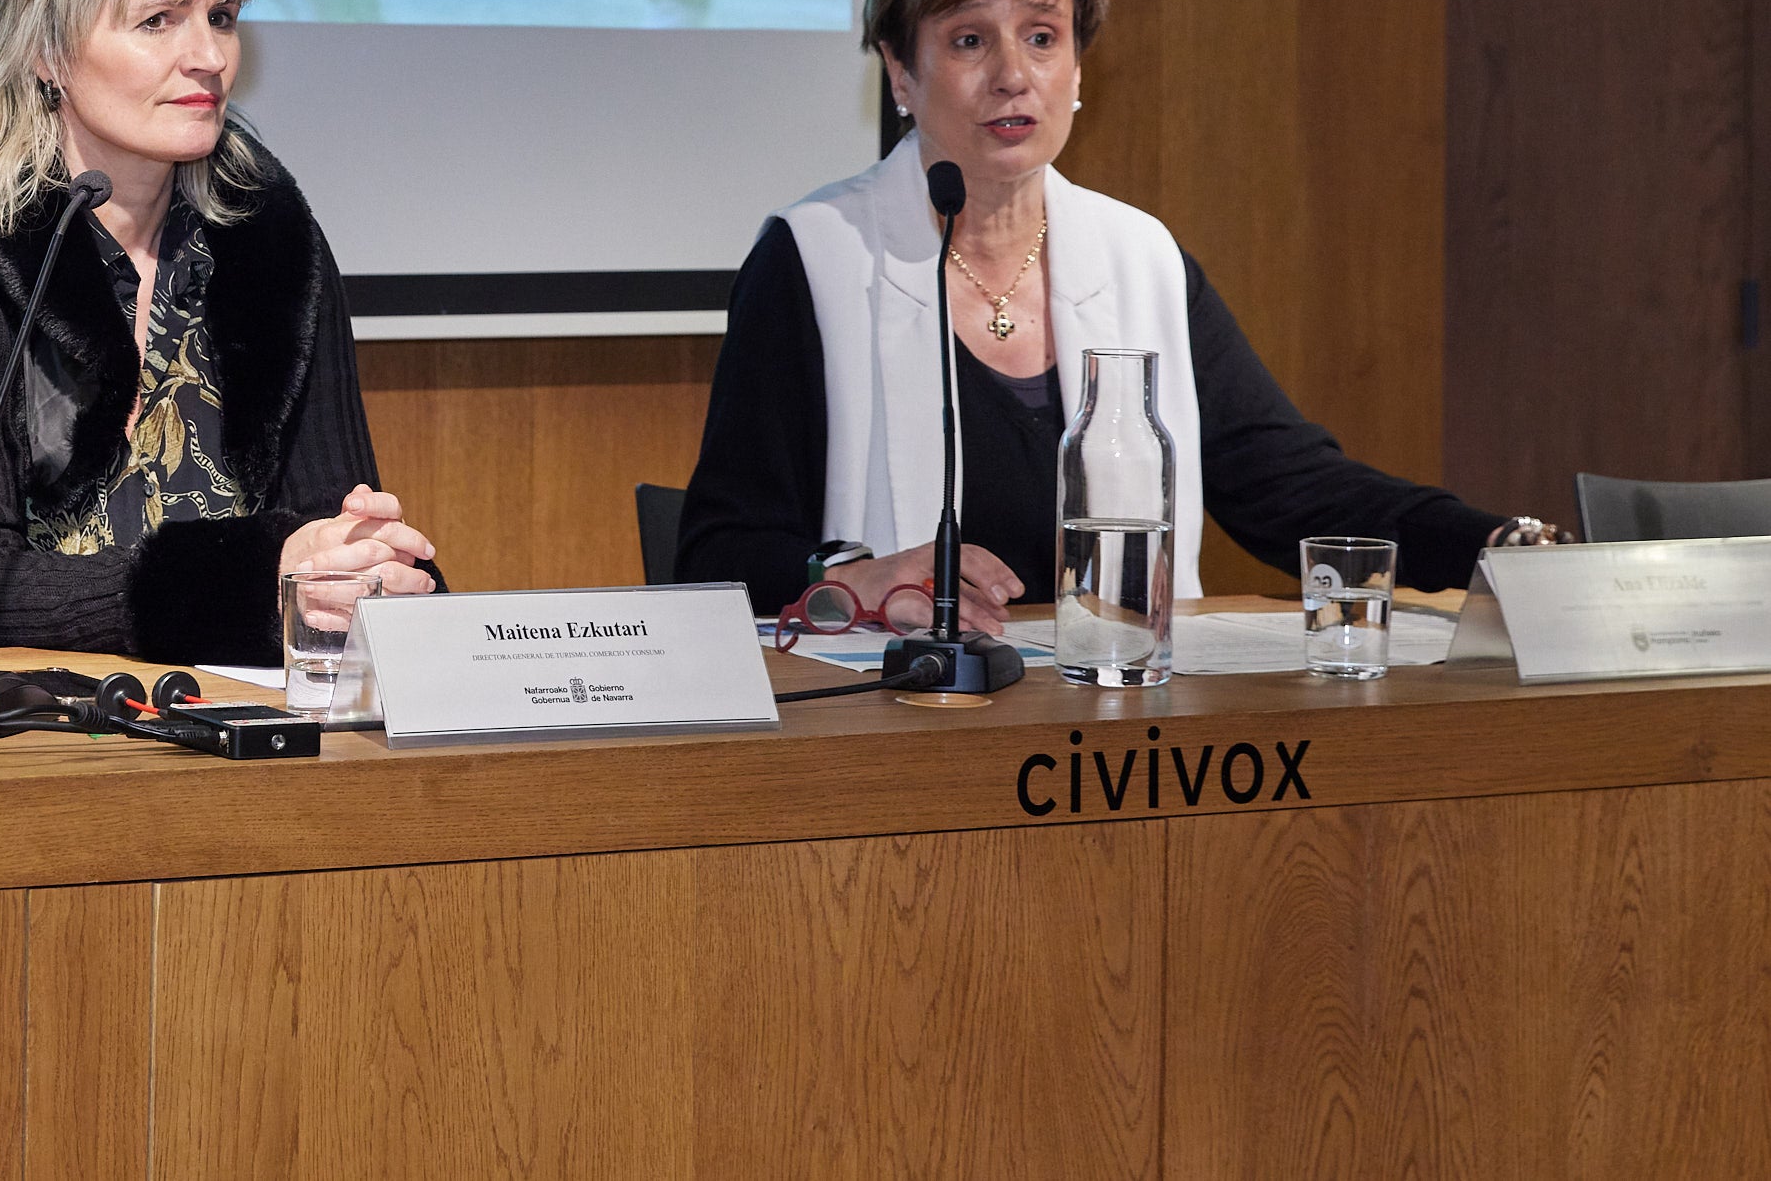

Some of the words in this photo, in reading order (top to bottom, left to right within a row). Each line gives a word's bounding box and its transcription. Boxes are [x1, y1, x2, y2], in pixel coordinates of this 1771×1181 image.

[484, 623, 562, 641] Maitena
[565, 620, 648, 639] Ezkutari
[472, 654, 512, 662] DIRECTORA
[589, 650, 624, 658] COMERCIO
[524, 686, 568, 695] Nafarroako
[588, 684, 624, 692] Gobierno
[531, 696, 570, 704] Gobernua
[603, 694, 633, 702] Navarra
[1017, 725, 1311, 816] civivox
